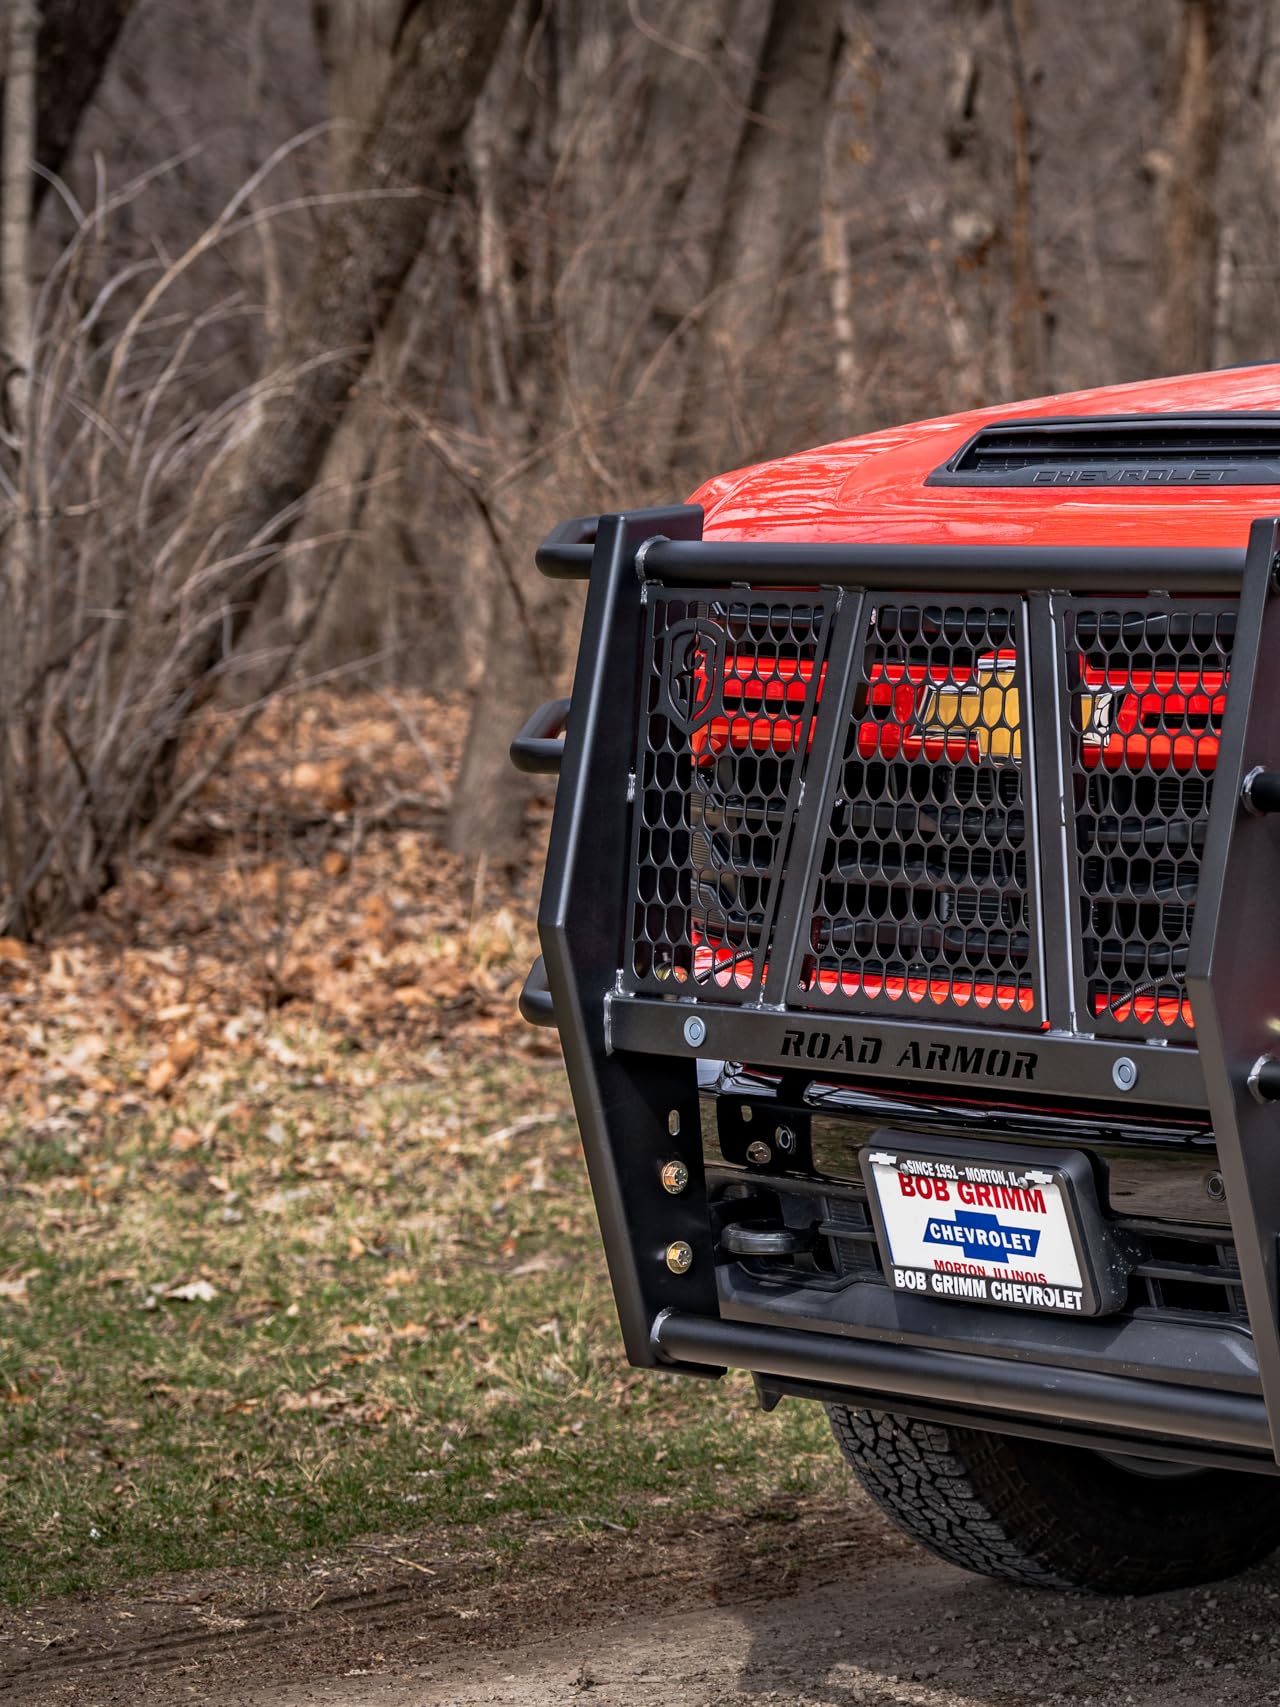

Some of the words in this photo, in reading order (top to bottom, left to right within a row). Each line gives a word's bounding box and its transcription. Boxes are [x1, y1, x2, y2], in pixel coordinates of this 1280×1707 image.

[1032, 468, 1239, 483] CHEVROLET
[780, 1029, 882, 1065] ROAD
[896, 1041, 1039, 1080] ARMOR
[905, 1159, 935, 1177] SINCE
[935, 1163, 959, 1180] 1951
[965, 1167, 1009, 1188] MORTON,
[1007, 1171, 1019, 1187] IL
[897, 1172, 951, 1202] BOB
[957, 1181, 1048, 1214] GRIMM
[930, 1222, 1032, 1251] CHEVROLET
[894, 1269, 928, 1291] BOB
[931, 1273, 987, 1299] GRIMM
[991, 1281, 1083, 1311] CHEVROLET
